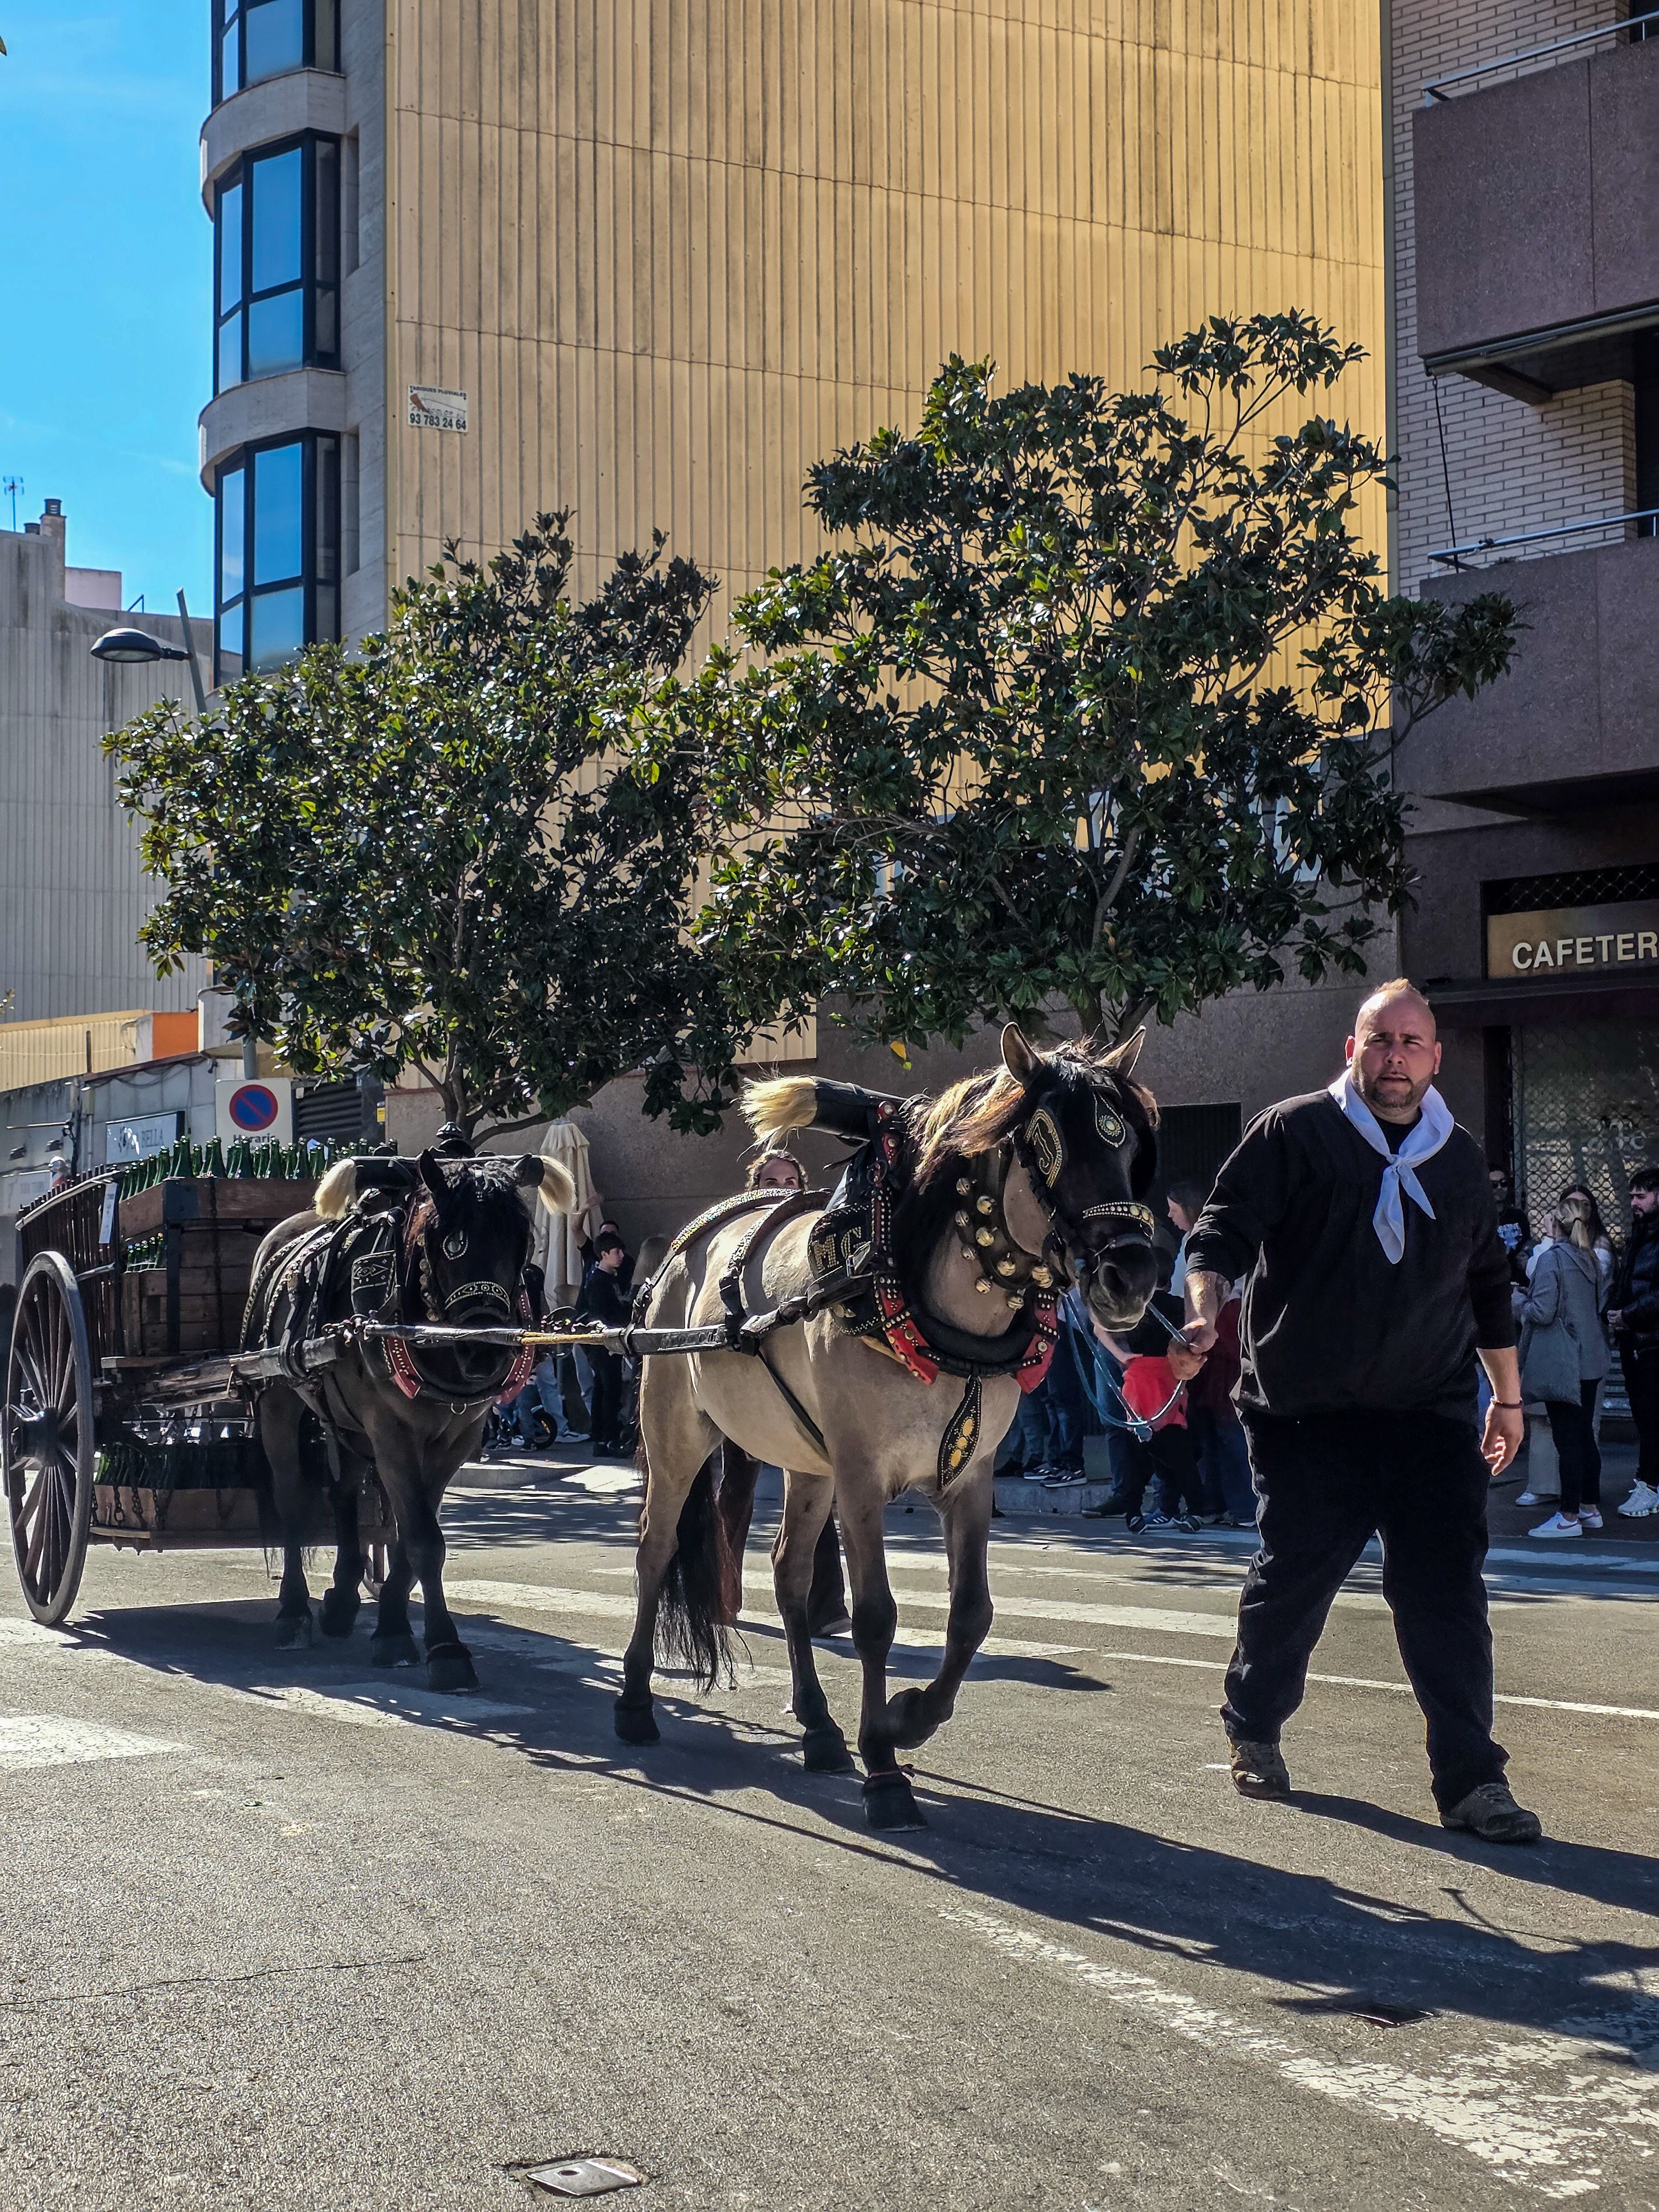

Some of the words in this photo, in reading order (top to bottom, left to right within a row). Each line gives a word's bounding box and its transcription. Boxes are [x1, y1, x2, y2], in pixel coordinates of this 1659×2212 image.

[410, 413, 421, 424] 93
[424, 415, 440, 426] 783
[442, 418, 453, 429] 24
[456, 419, 466, 430] 64
[1512, 931, 1658, 969] CAFETER
[233, 1133, 276, 1144] Hrari
